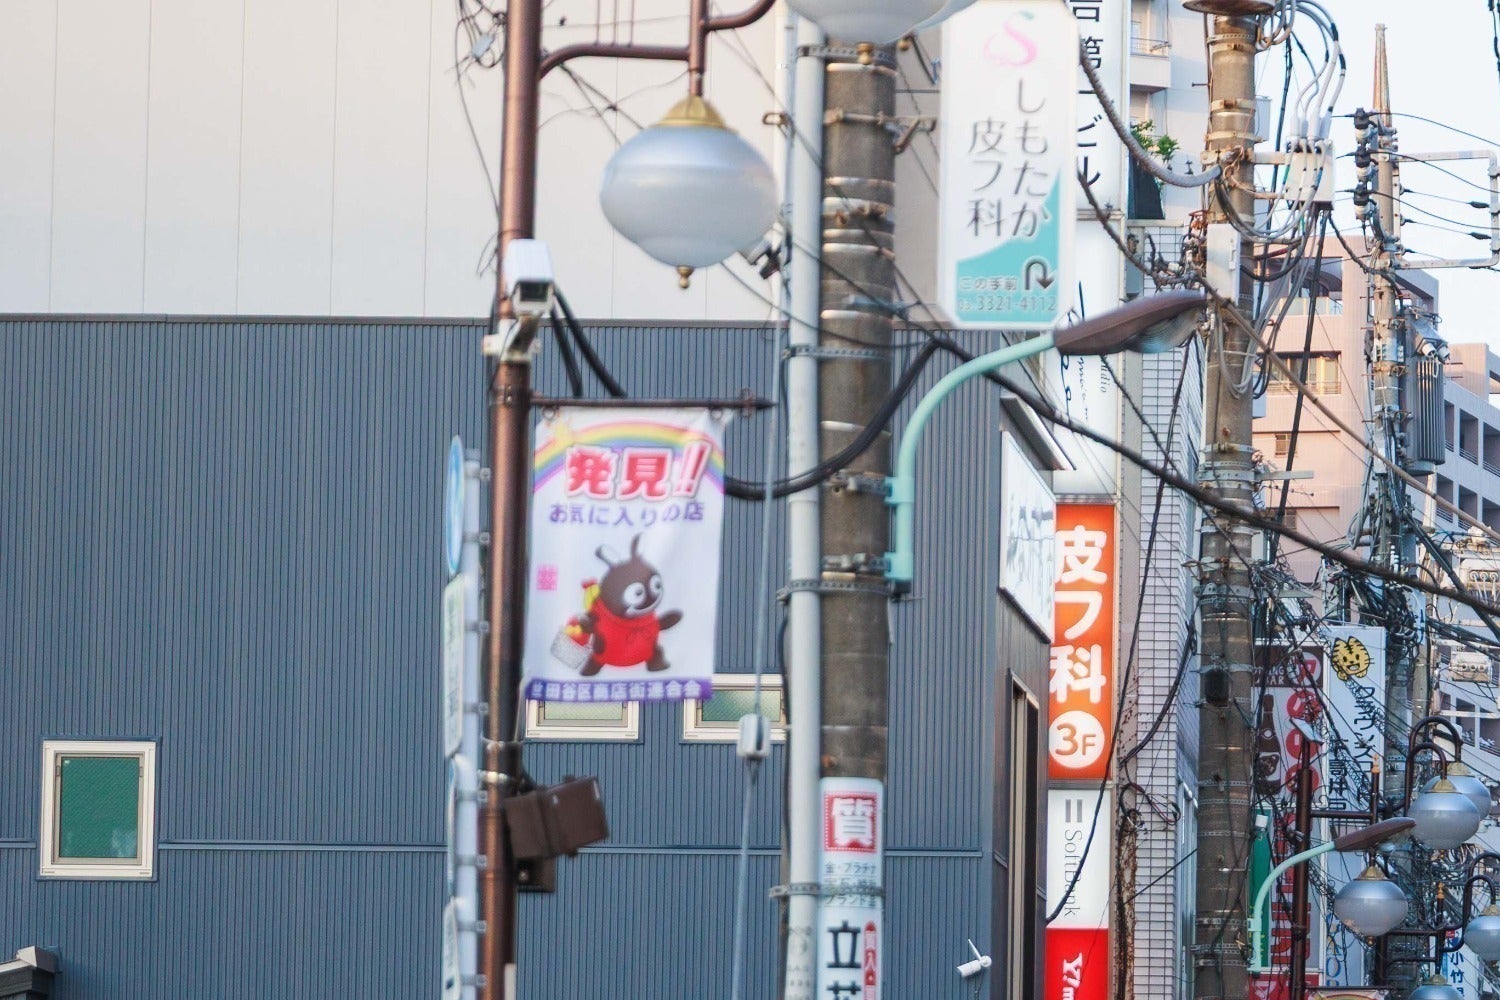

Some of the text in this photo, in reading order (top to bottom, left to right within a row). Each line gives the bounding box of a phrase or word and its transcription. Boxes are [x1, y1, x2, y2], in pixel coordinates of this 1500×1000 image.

[967, 116, 1010, 238] 皮フ科
[1012, 77, 1050, 238] しもたか
[549, 501, 705, 527] お気に入りの店
[1050, 525, 1108, 704] 皮フ科
[1054, 722, 1097, 757] 3F
